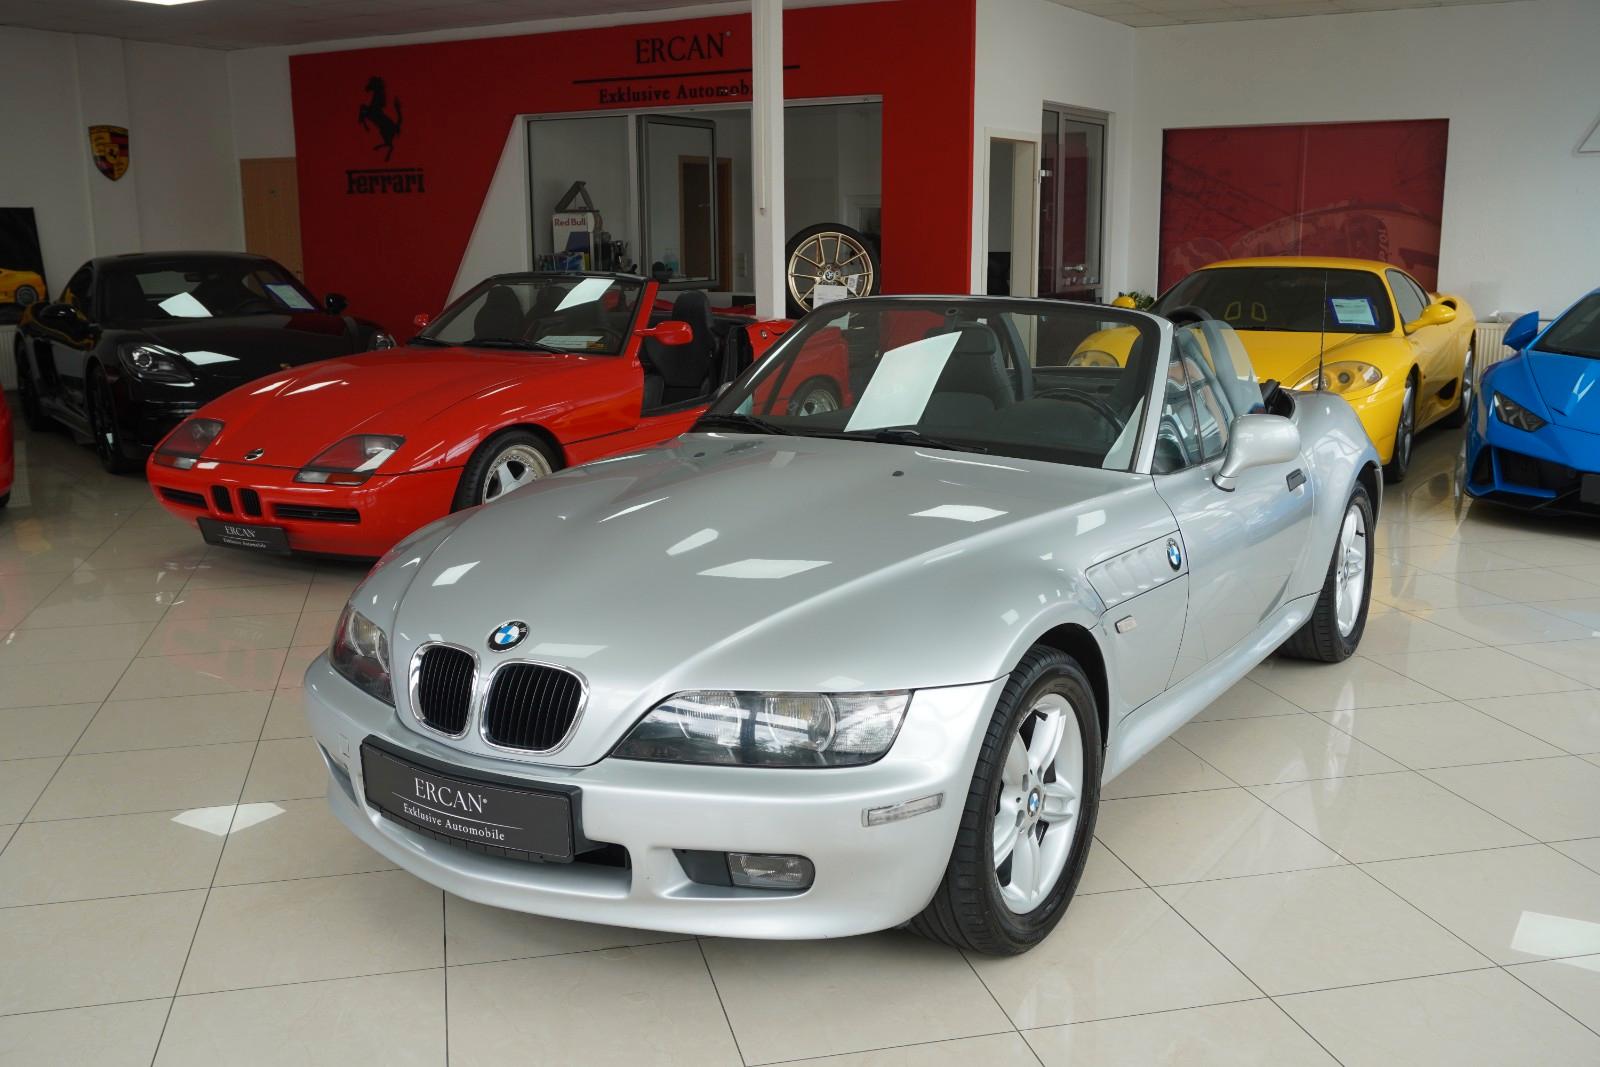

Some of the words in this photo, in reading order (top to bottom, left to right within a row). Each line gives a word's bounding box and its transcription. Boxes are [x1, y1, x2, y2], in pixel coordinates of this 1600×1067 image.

[599, 85, 671, 105] Exklusive
[676, 79, 752, 100] Automob
[345, 167, 425, 194] Ferrari
[554, 218, 570, 226] Red
[571, 218, 586, 226] Bull
[403, 802, 442, 826] Exklusive
[444, 819, 505, 841] Automobile
